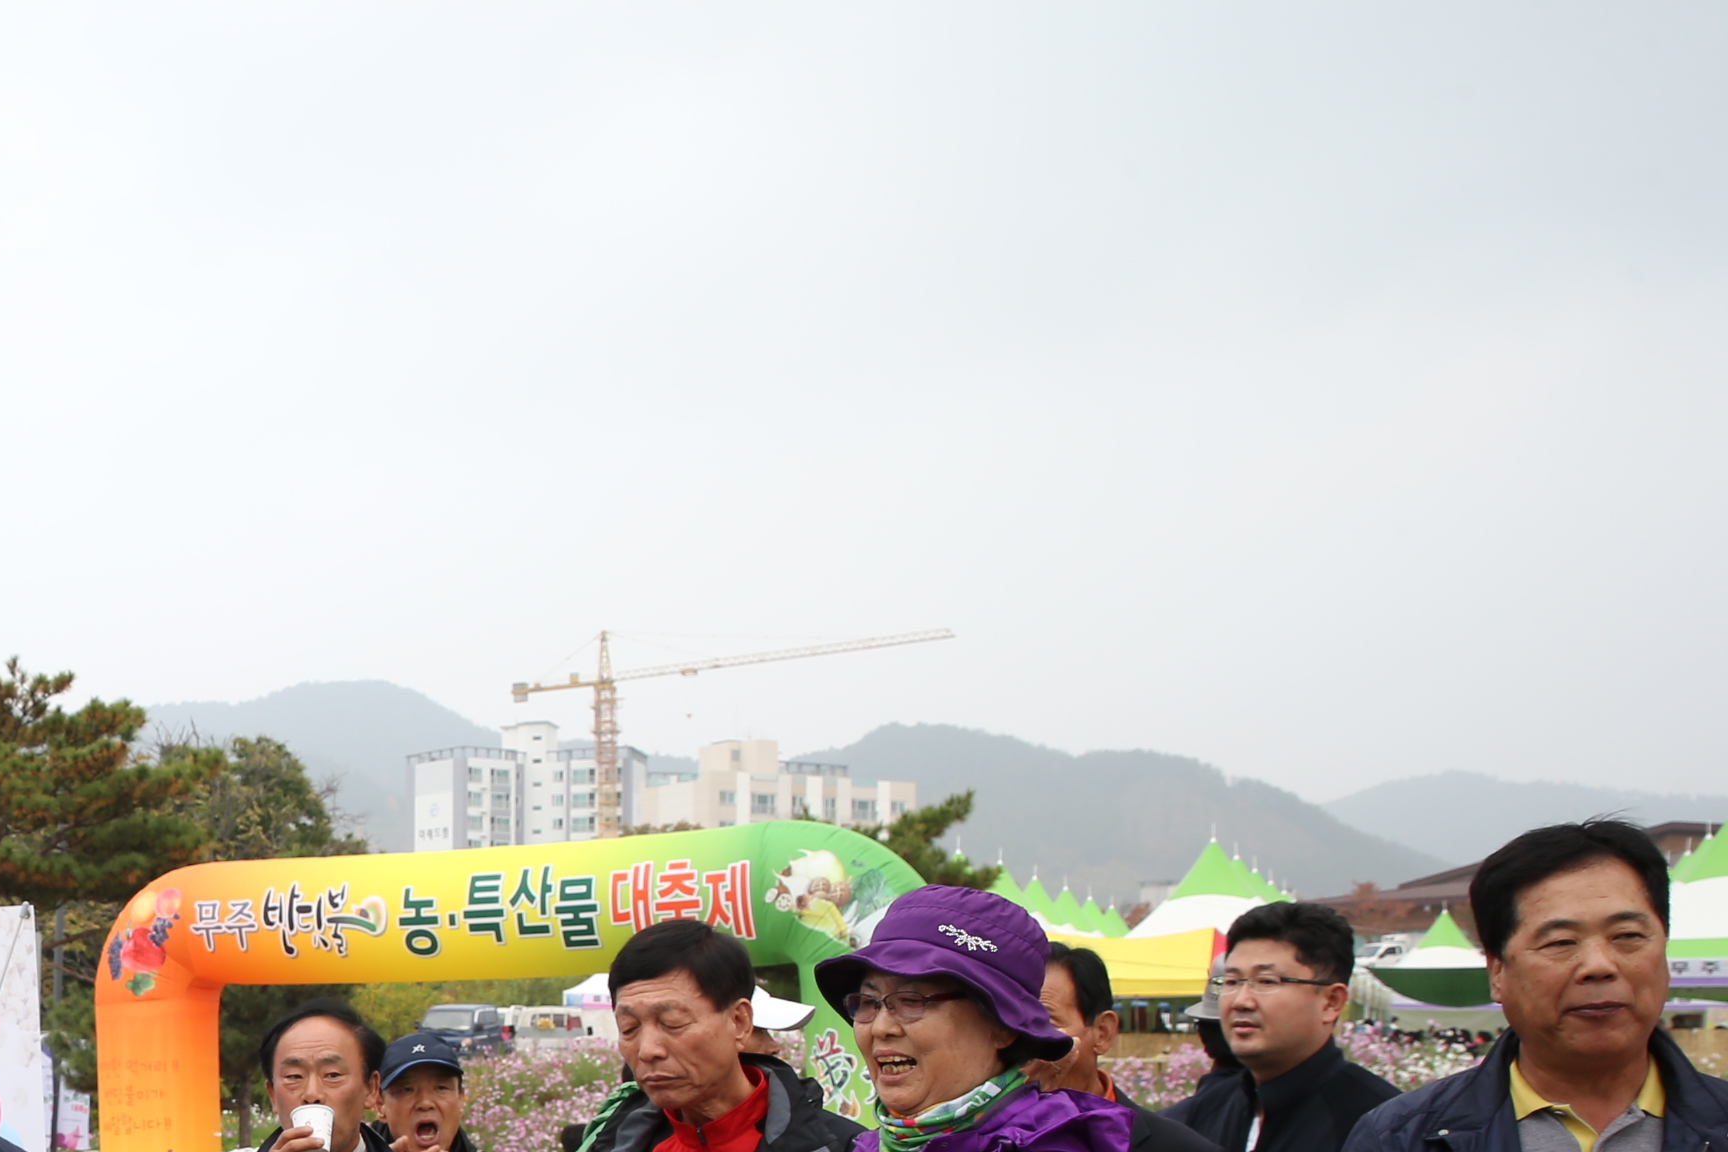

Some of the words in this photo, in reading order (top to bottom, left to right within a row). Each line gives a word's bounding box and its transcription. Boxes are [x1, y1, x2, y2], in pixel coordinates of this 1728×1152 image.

[190, 901, 258, 952] 무주
[263, 882, 380, 957] 반딧불
[610, 859, 757, 940] 대축제
